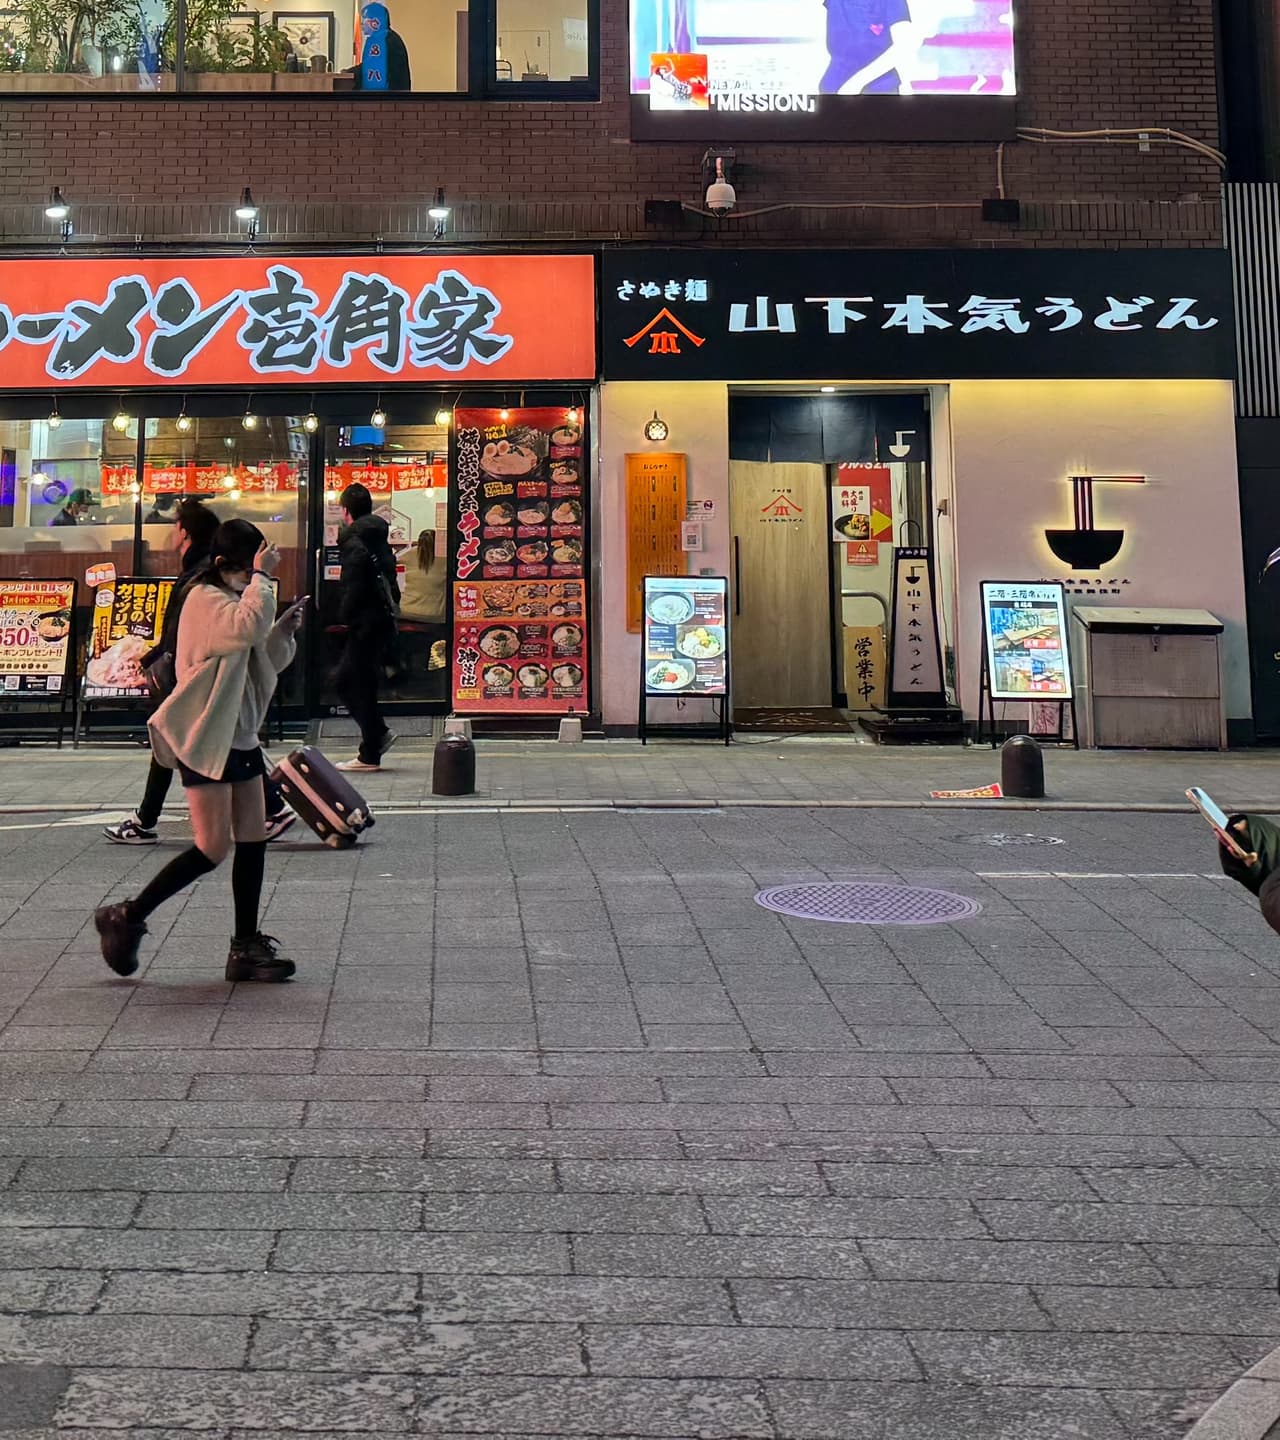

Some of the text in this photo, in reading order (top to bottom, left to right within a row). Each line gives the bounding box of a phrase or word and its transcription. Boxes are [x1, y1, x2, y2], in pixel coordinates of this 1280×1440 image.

[616, 280, 708, 302] さぬき麺
[728, 295, 1219, 334] 山下本気うどん
[855, 637, 875, 703] 営業中
